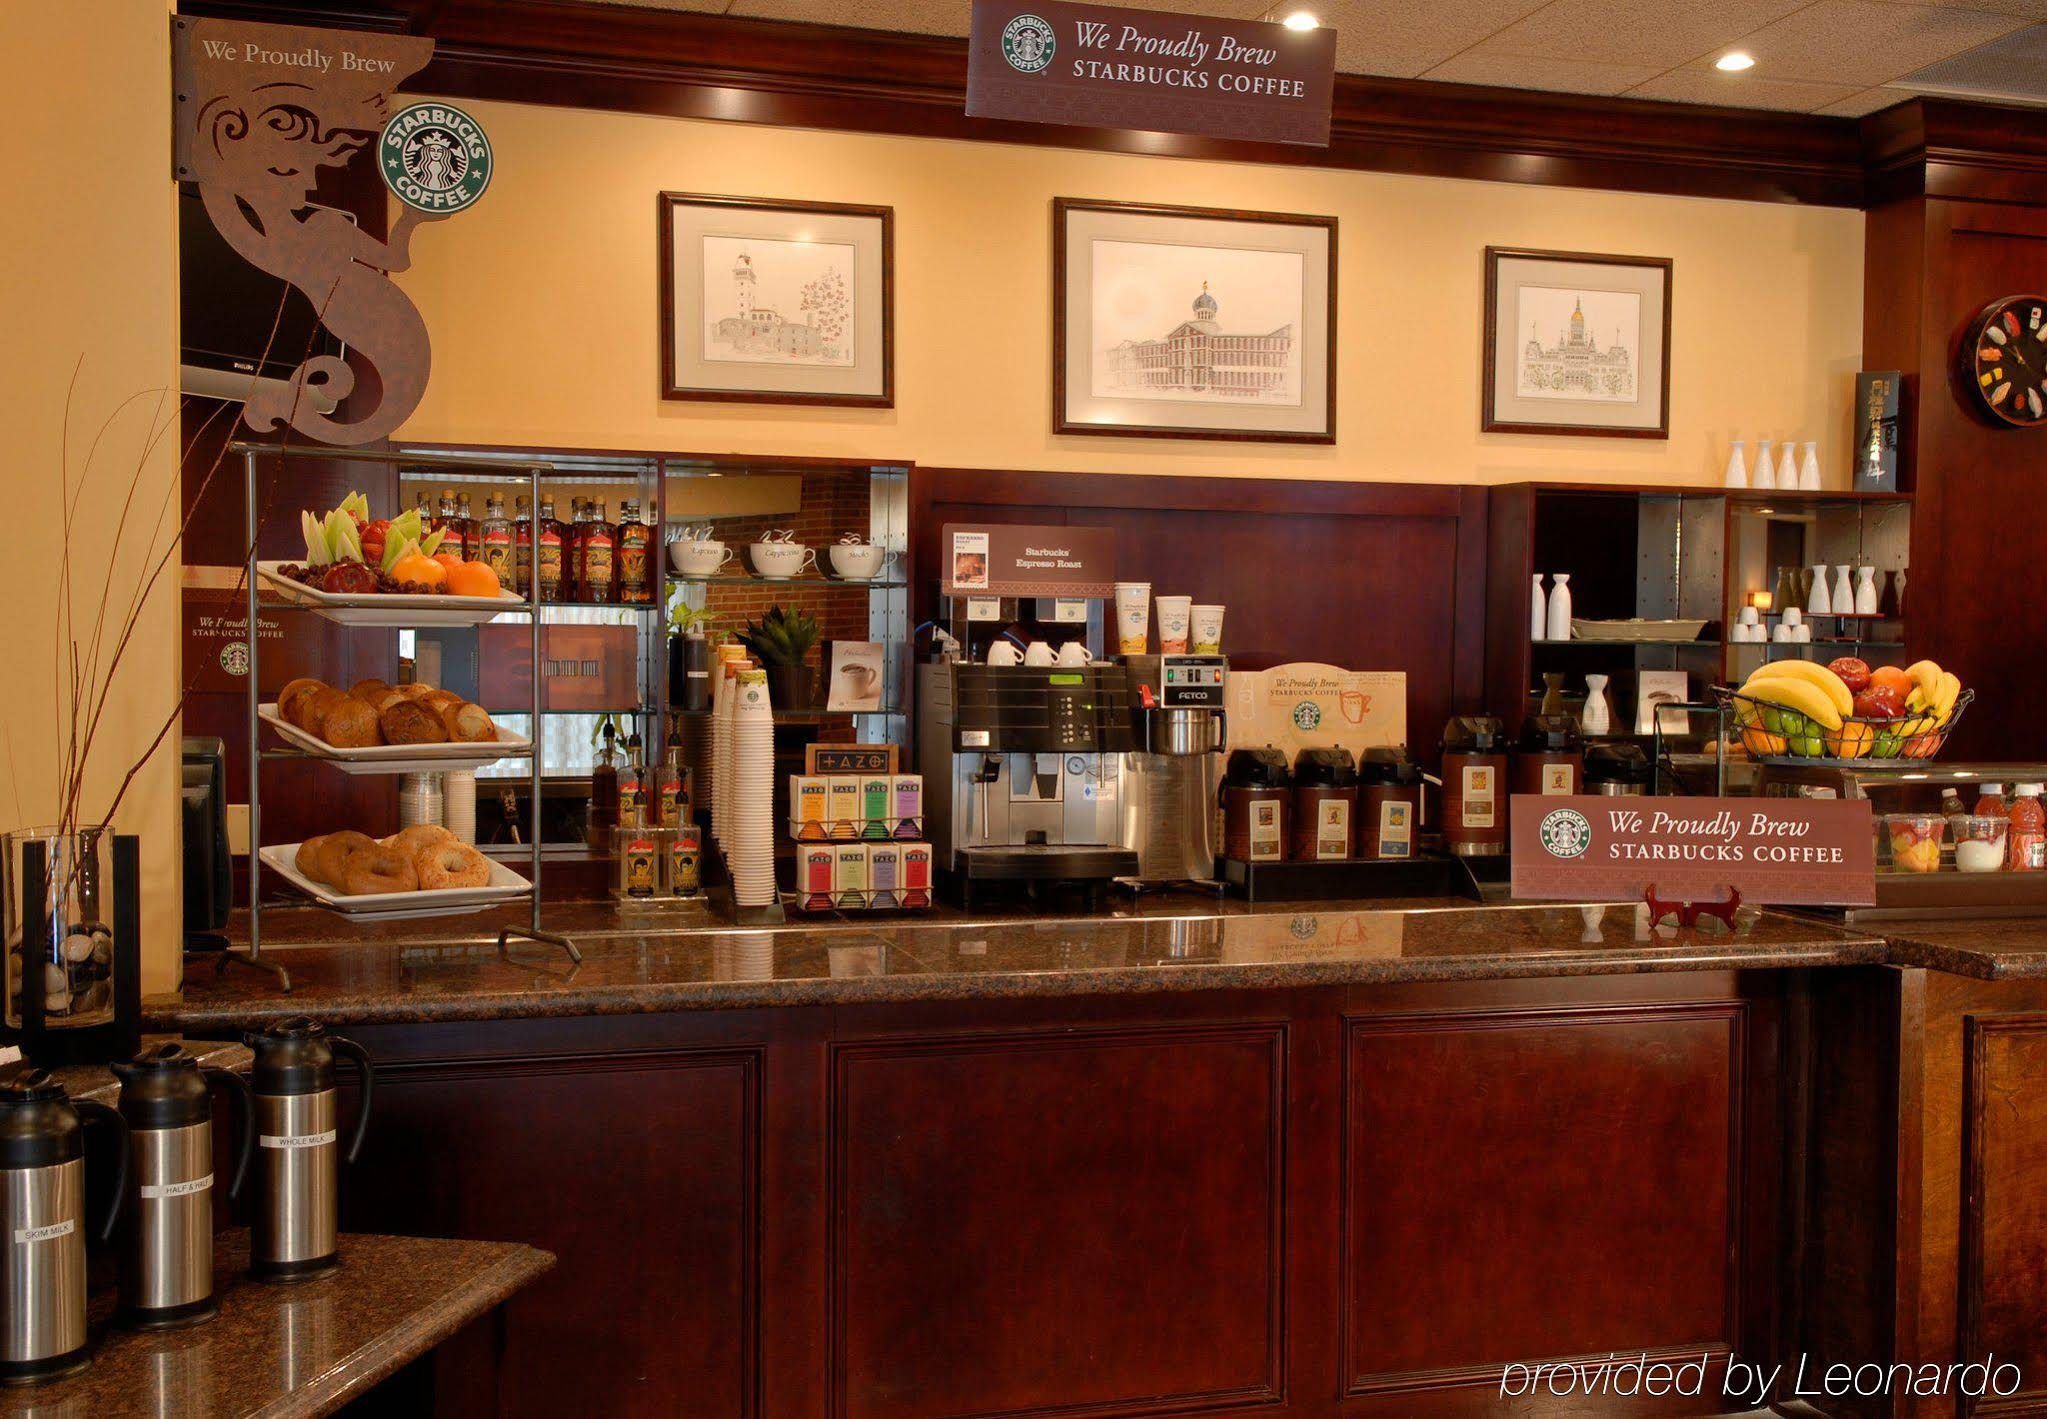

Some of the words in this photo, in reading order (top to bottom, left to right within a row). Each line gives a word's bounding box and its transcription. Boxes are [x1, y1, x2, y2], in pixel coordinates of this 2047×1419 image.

[1005, 17, 1053, 43] STARBUCKS
[1075, 21, 1109, 49] We
[1115, 26, 1209, 64] Proudly
[1215, 36, 1276, 66] Brew
[202, 39, 236, 61] We
[245, 43, 333, 73] Proudly
[341, 52, 396, 74] Brew
[1008, 53, 1046, 71] COFFEE
[1073, 60, 1209, 89] STARBUCKS
[1218, 74, 1305, 98] COFFEE
[387, 109, 486, 160] STARBUCKS
[396, 176, 470, 206] COFFEE
[1025, 547, 1070, 557] Starbucks
[1016, 559, 1055, 569] Espresso
[1057, 559, 1082, 569] Roast
[200, 617, 214, 627] We
[216, 617, 248, 631] Proudl
[192, 629, 246, 637] STARUCKS
[1275, 679, 1287, 687] We
[1289, 679, 1318, 690] Proudly
[1320, 679, 1339, 688] Brew
[1179, 692, 1208, 700] FETCO
[803, 786, 825, 794] TAZO
[835, 785, 856, 793] TAZO
[898, 784, 919, 792] TAZO
[1543, 811, 1588, 833] STARBUCKS
[1608, 811, 1642, 833] We
[1649, 811, 1741, 841] Proudly
[1748, 814, 1810, 837] Brew
[1548, 842, 1583, 856] COFFEE
[1609, 843, 1744, 861] STARBUCKS
[1754, 846, 1843, 864] COFFEE
[280, 1138, 307, 1146] WHOLE
[166, 1185, 187, 1193] HALF
[25, 1229, 48, 1239] SKIM
[50, 1224, 69, 1234] MILK
